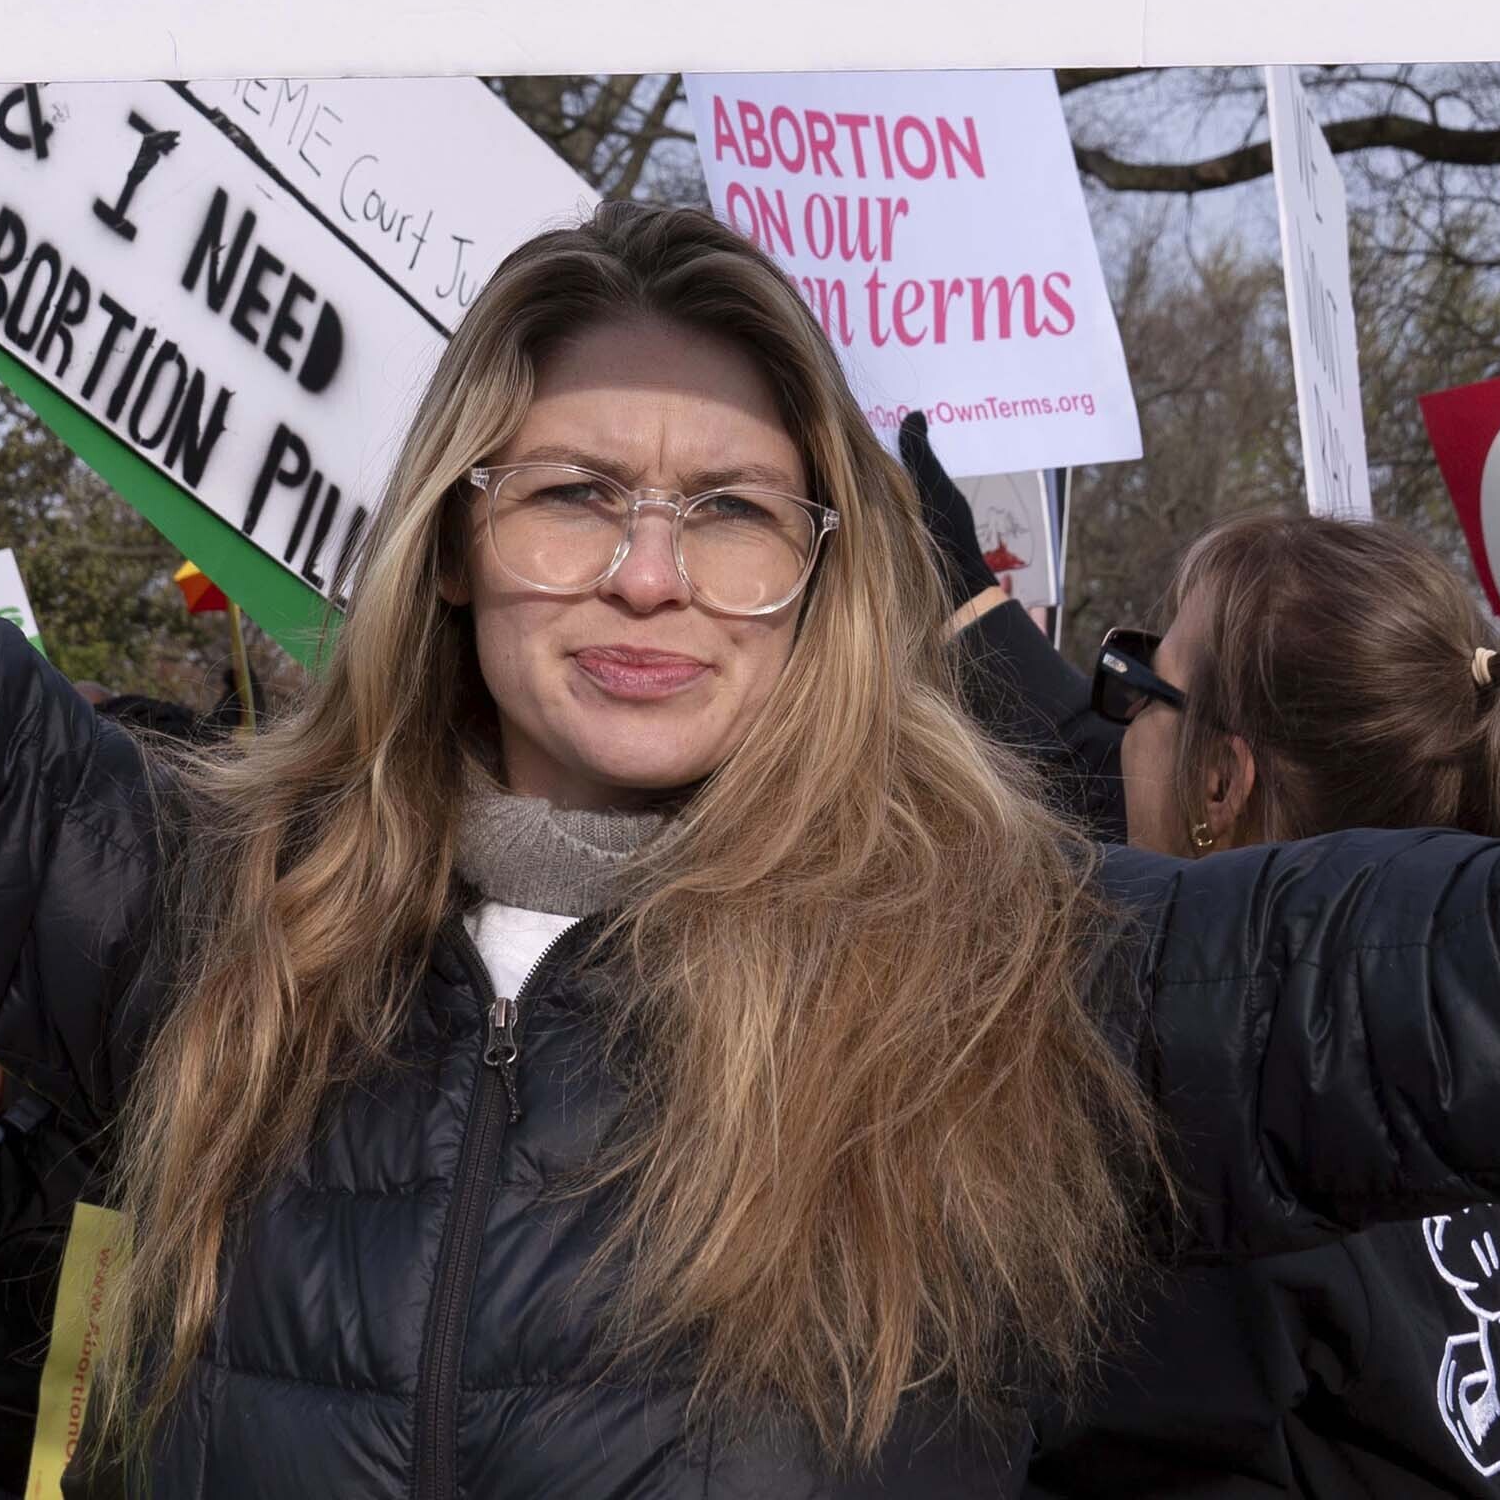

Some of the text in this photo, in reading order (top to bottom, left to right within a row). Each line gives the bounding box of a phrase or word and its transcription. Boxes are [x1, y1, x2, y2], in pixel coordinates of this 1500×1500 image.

[712, 94, 987, 181] ABORTION
[92, 110, 181, 243] I
[181, 186, 346, 395] NEED
[338, 153, 435, 271] Court
[726, 181, 911, 265] ON our
[866, 268, 1077, 349] terms
